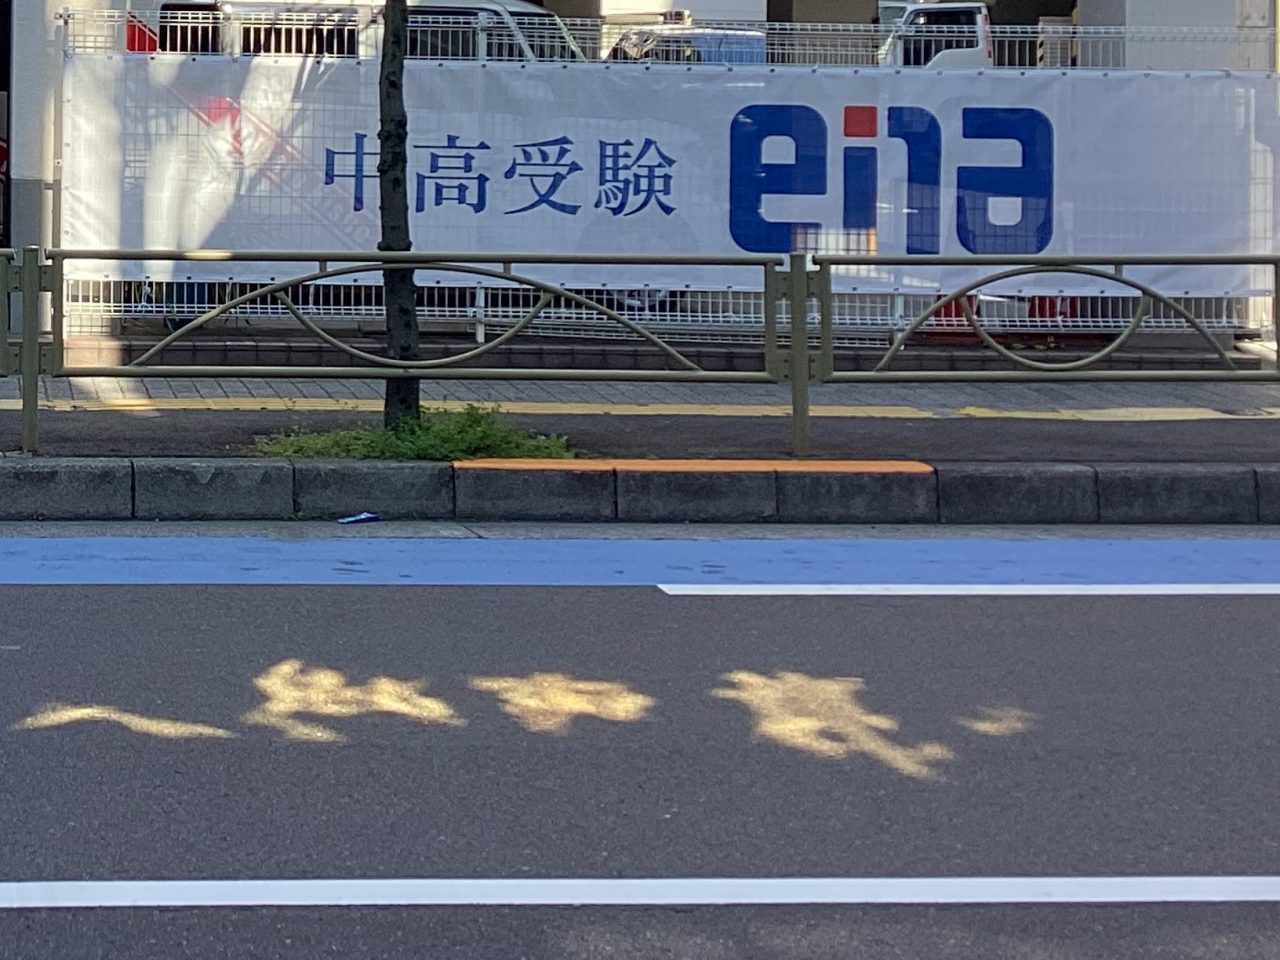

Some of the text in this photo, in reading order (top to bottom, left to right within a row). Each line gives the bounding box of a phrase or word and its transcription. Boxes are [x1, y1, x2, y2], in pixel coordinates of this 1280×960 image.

[323, 132, 678, 217] 中高受験
[729, 104, 1054, 255] ena
